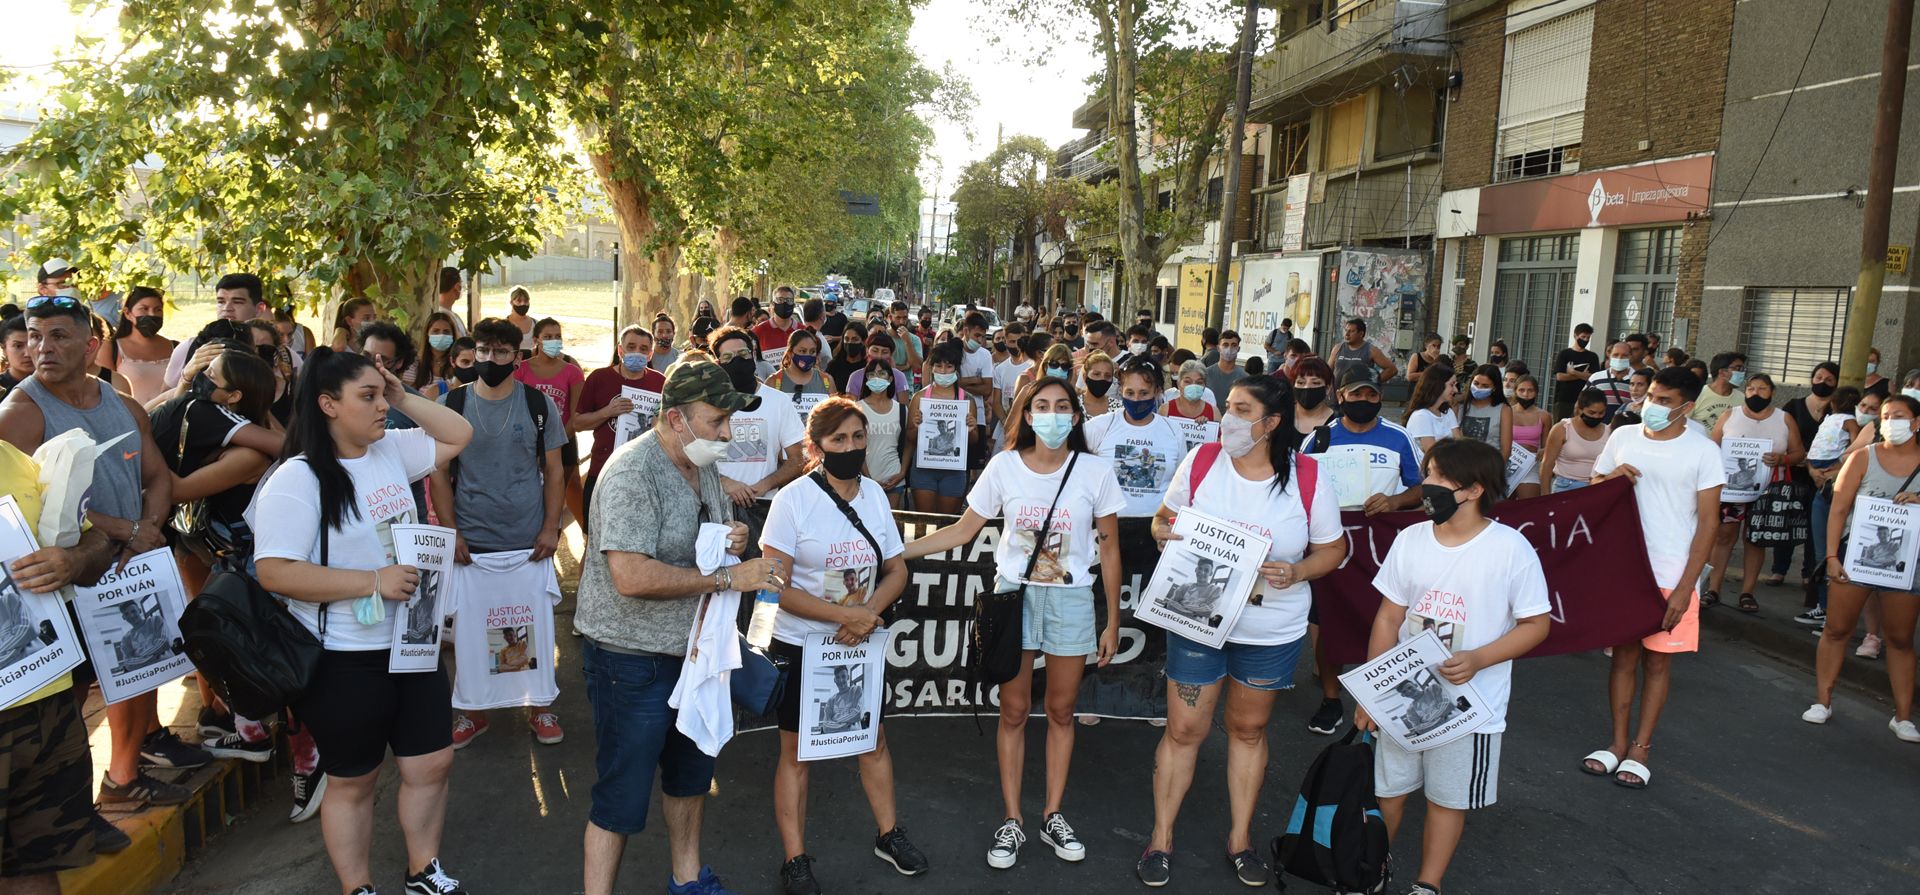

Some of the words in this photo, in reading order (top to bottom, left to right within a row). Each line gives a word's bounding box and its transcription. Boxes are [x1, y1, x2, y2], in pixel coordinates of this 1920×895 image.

[1605, 192, 1624, 206] beta
[1632, 191, 1656, 203] Limpieza
[1656, 184, 1689, 202] profesional
[1243, 311, 1278, 329] GOLDEN
[631, 393, 659, 404] JUSTICIA
[1179, 423, 1207, 431] USTICIA
[1126, 438, 1153, 447] FABIÁN
[366, 483, 406, 508] JUSTICIA
[369, 505, 390, 521] POR
[391, 496, 413, 517] IVAN
[1869, 503, 1909, 516] JUSTICIA
[1016, 518, 1040, 531] POR
[1868, 514, 1885, 523] POR
[1887, 516, 1907, 526] IVÁN
[414, 534, 446, 549] JUSTICIA
[1194, 521, 1246, 549] JUSTICIA
[1750, 531, 1790, 543] green
[828, 539, 871, 555] JUSTICI
[1190, 538, 1212, 553] POR
[1213, 546, 1240, 563] IVÁN
[417, 552, 430, 563] POR
[430, 553, 443, 565] IVÁN
[825, 555, 849, 568] POR
[99, 562, 152, 587] USTICIA
[1852, 566, 1903, 580] #JusticiaPorIván
[97, 586, 124, 603] POR
[126, 578, 156, 597] IVÁN
[1425, 589, 1465, 607] STICIA
[488, 605, 532, 617] JUSTICIA
[1435, 606, 1467, 622] IVAN
[486, 618, 508, 627] POR
[510, 614, 534, 625] IVAN
[1149, 606, 1215, 637] #JusticiaPorIván
[822, 652, 842, 661] POR
[844, 647, 867, 660] IVÁN
[115, 656, 187, 688] #JusticiaPorIván
[1364, 647, 1418, 682] JUSTICIA
[1373, 675, 1397, 691] POR
[1399, 657, 1425, 679] IVÁN
[1410, 710, 1478, 745] #JusticiaPorIván
[810, 733, 869, 747] #JusticiaPorIván
